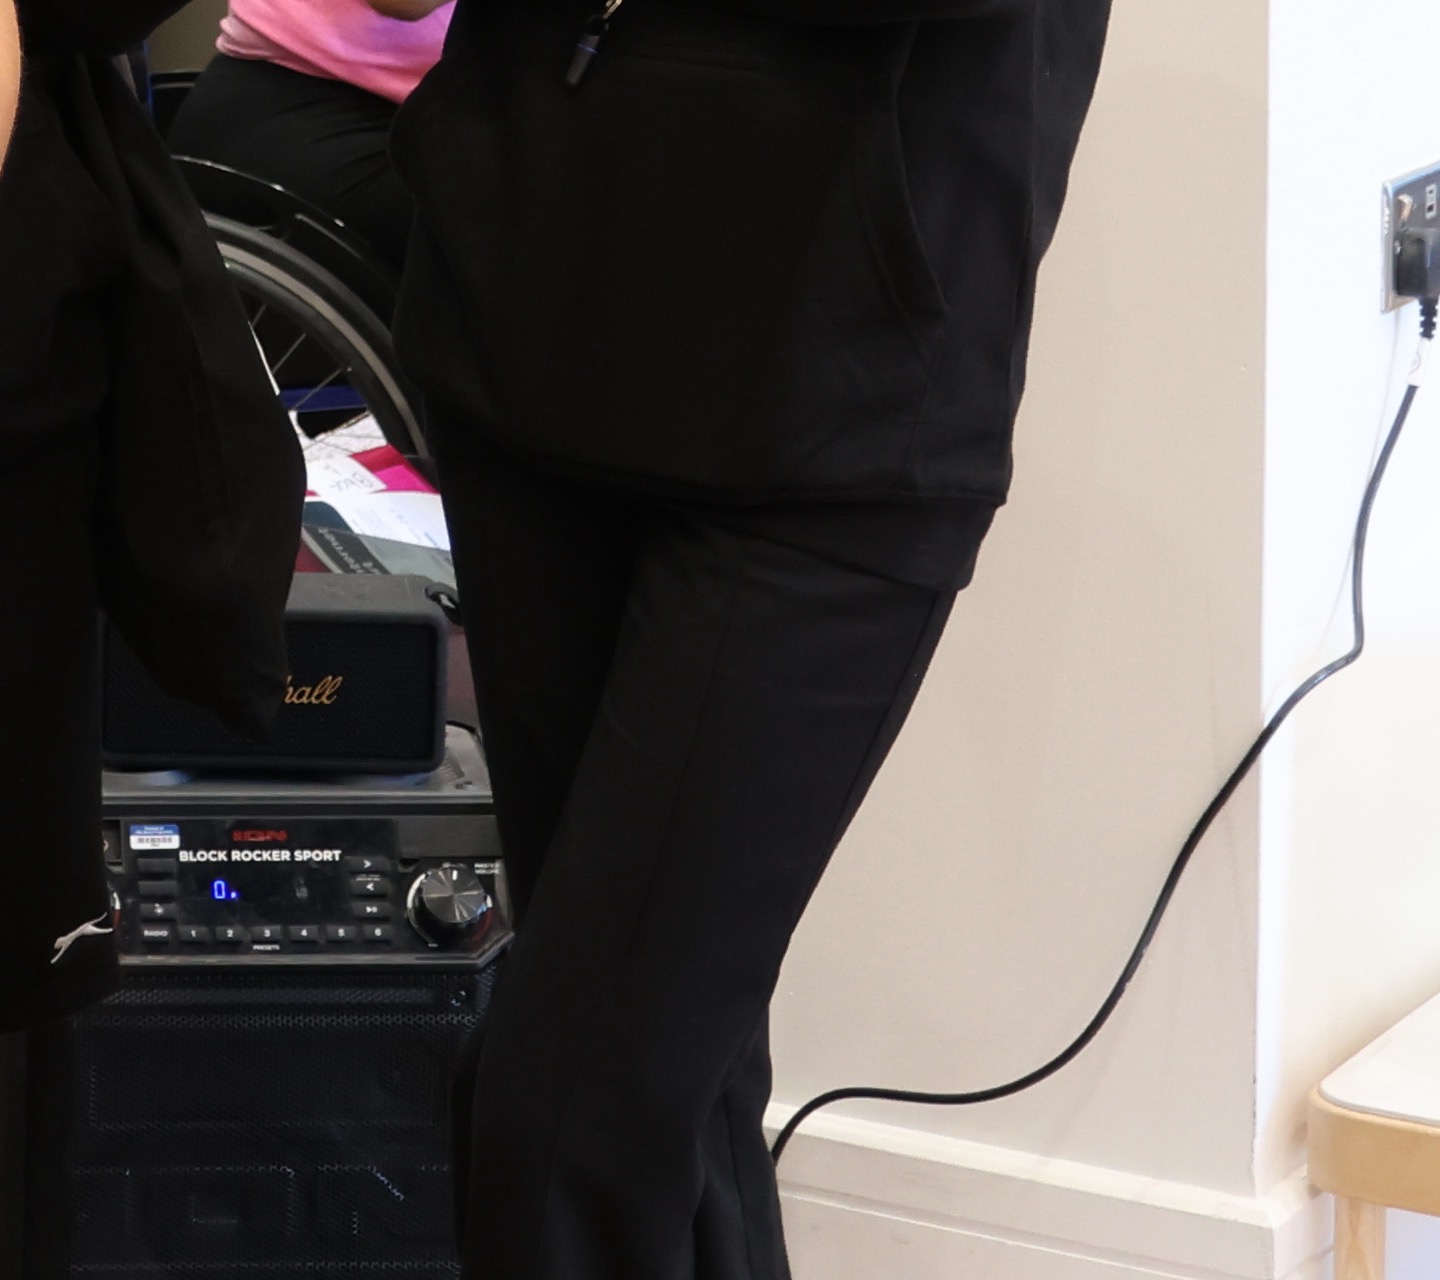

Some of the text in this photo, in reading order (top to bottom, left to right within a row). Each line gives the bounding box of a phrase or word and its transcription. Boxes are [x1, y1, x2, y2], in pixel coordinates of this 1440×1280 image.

[179, 849, 342, 862] BLOCK ROCKER SPORT
[190, 928, 197, 938] 1
[227, 928, 234, 938] 2
[263, 928, 271, 938] 3
[300, 928, 308, 938] 4
